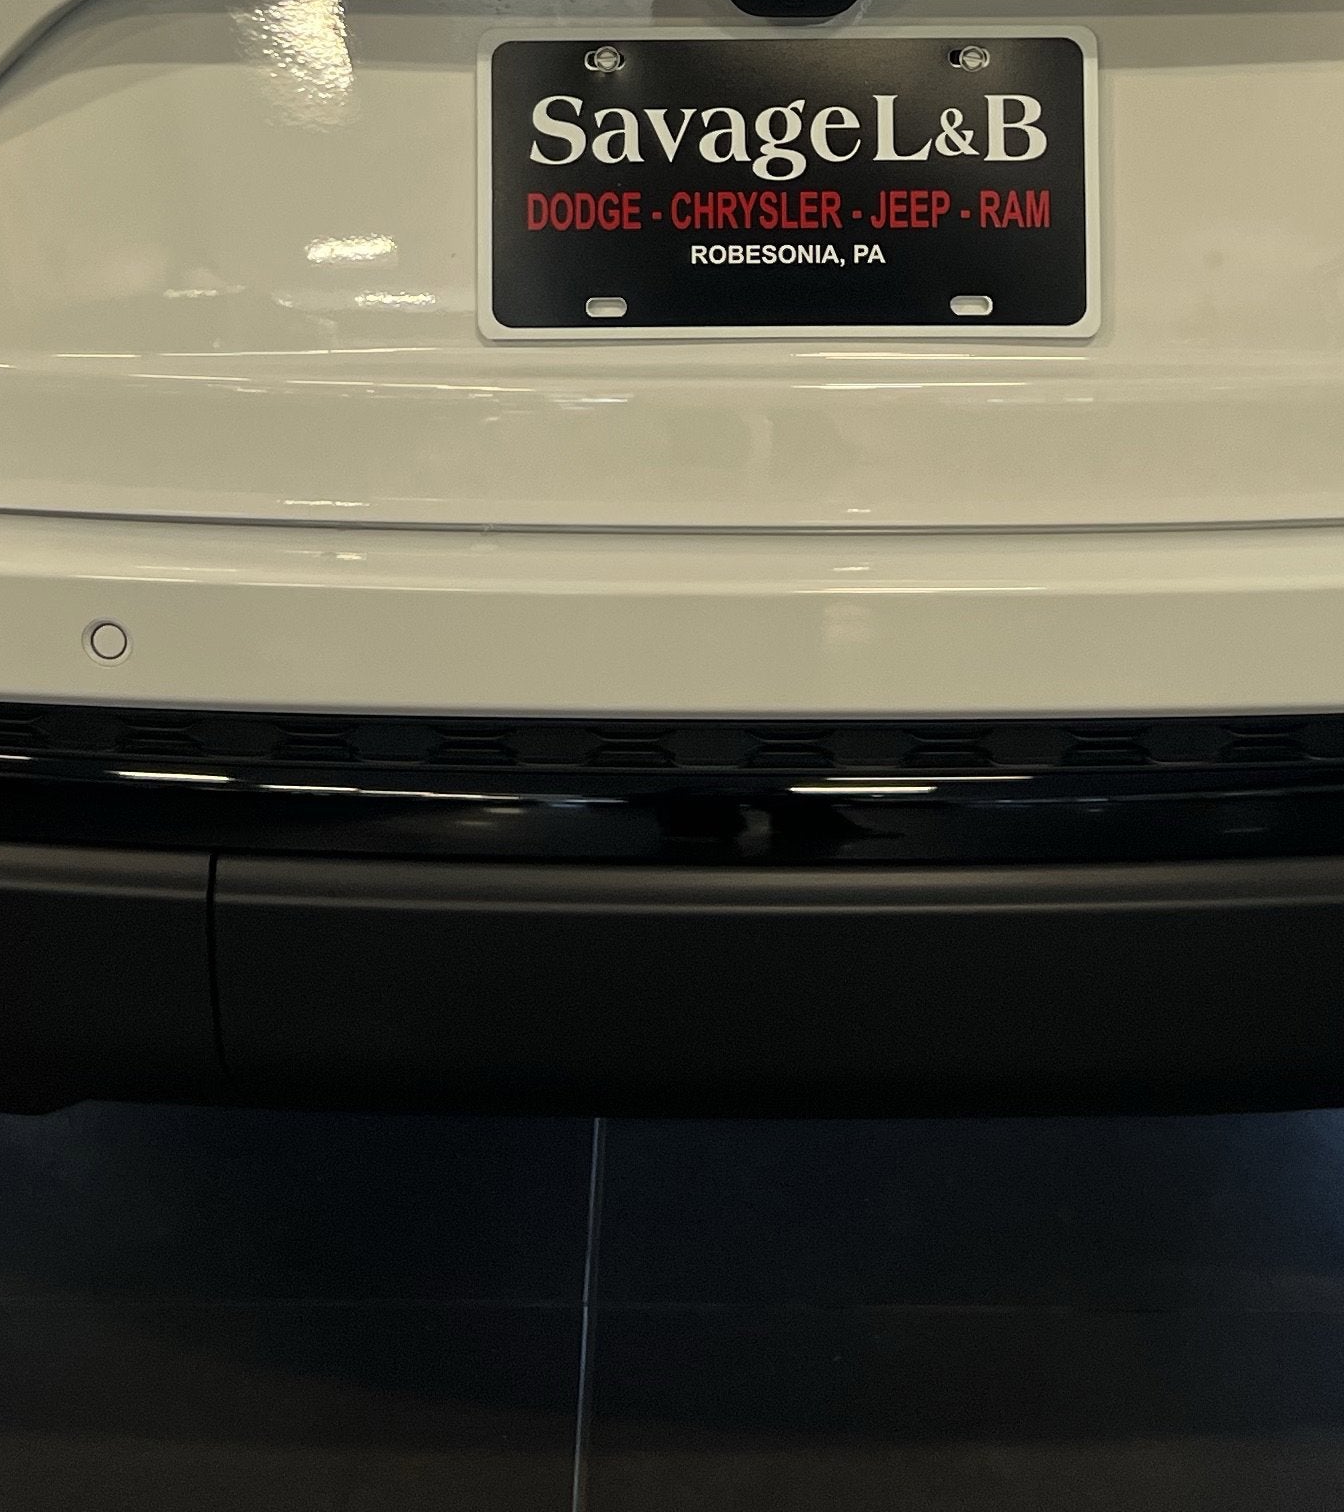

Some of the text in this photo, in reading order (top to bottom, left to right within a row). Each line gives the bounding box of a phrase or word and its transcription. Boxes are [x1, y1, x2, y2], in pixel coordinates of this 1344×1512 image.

[527, 190, 642, 231] DODGE
[670, 189, 843, 230] CHRYSLER
[869, 188, 952, 229] JEEP
[979, 188, 1051, 228] RAM
[691, 244, 887, 268] ROBESONIA, PA
